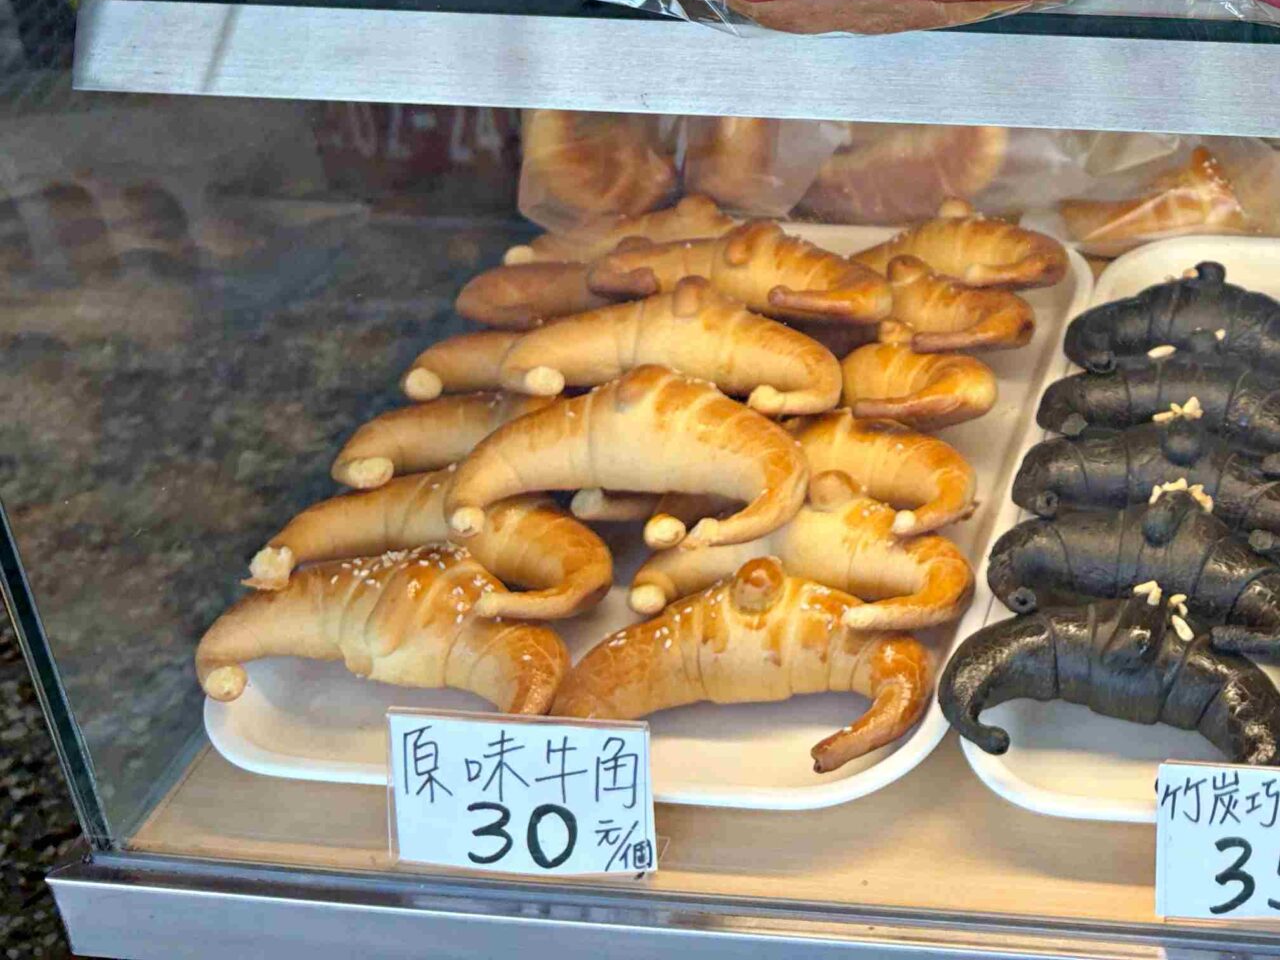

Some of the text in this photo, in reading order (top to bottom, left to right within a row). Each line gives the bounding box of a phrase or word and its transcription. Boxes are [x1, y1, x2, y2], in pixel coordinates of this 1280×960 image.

[403, 725, 641, 810] 原味牛角
[467, 801, 578, 870] 30
